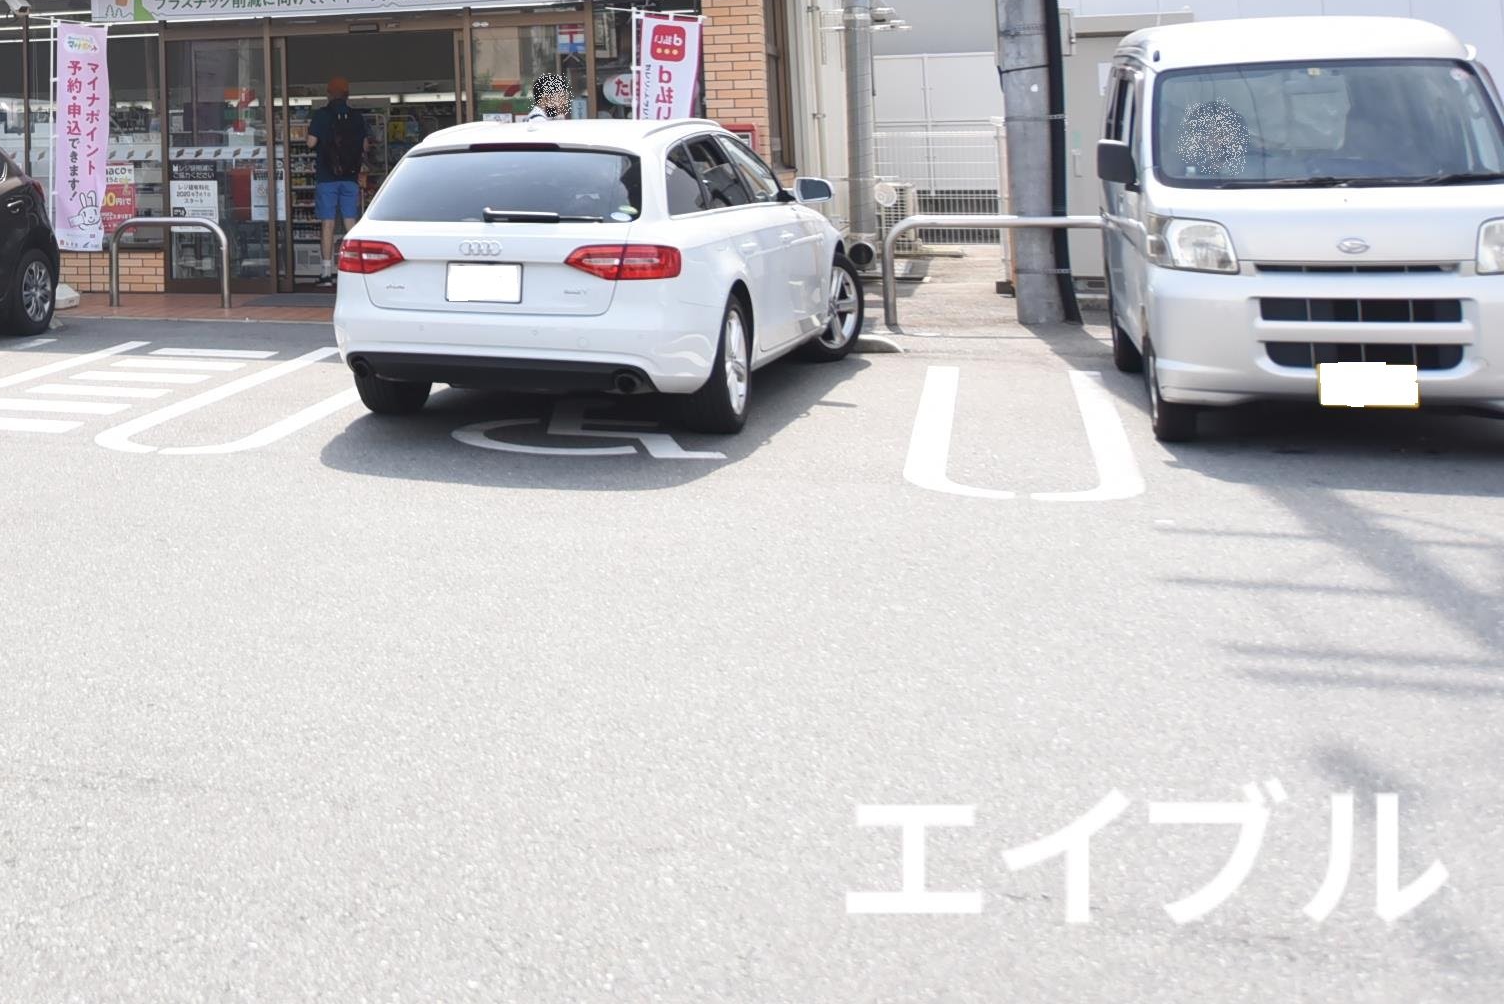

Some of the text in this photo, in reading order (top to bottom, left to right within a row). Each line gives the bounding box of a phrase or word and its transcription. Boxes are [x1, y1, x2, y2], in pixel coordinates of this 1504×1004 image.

[67, 60, 82, 202] 予約・申込できます！
[86, 62, 100, 176] マイナポイント
